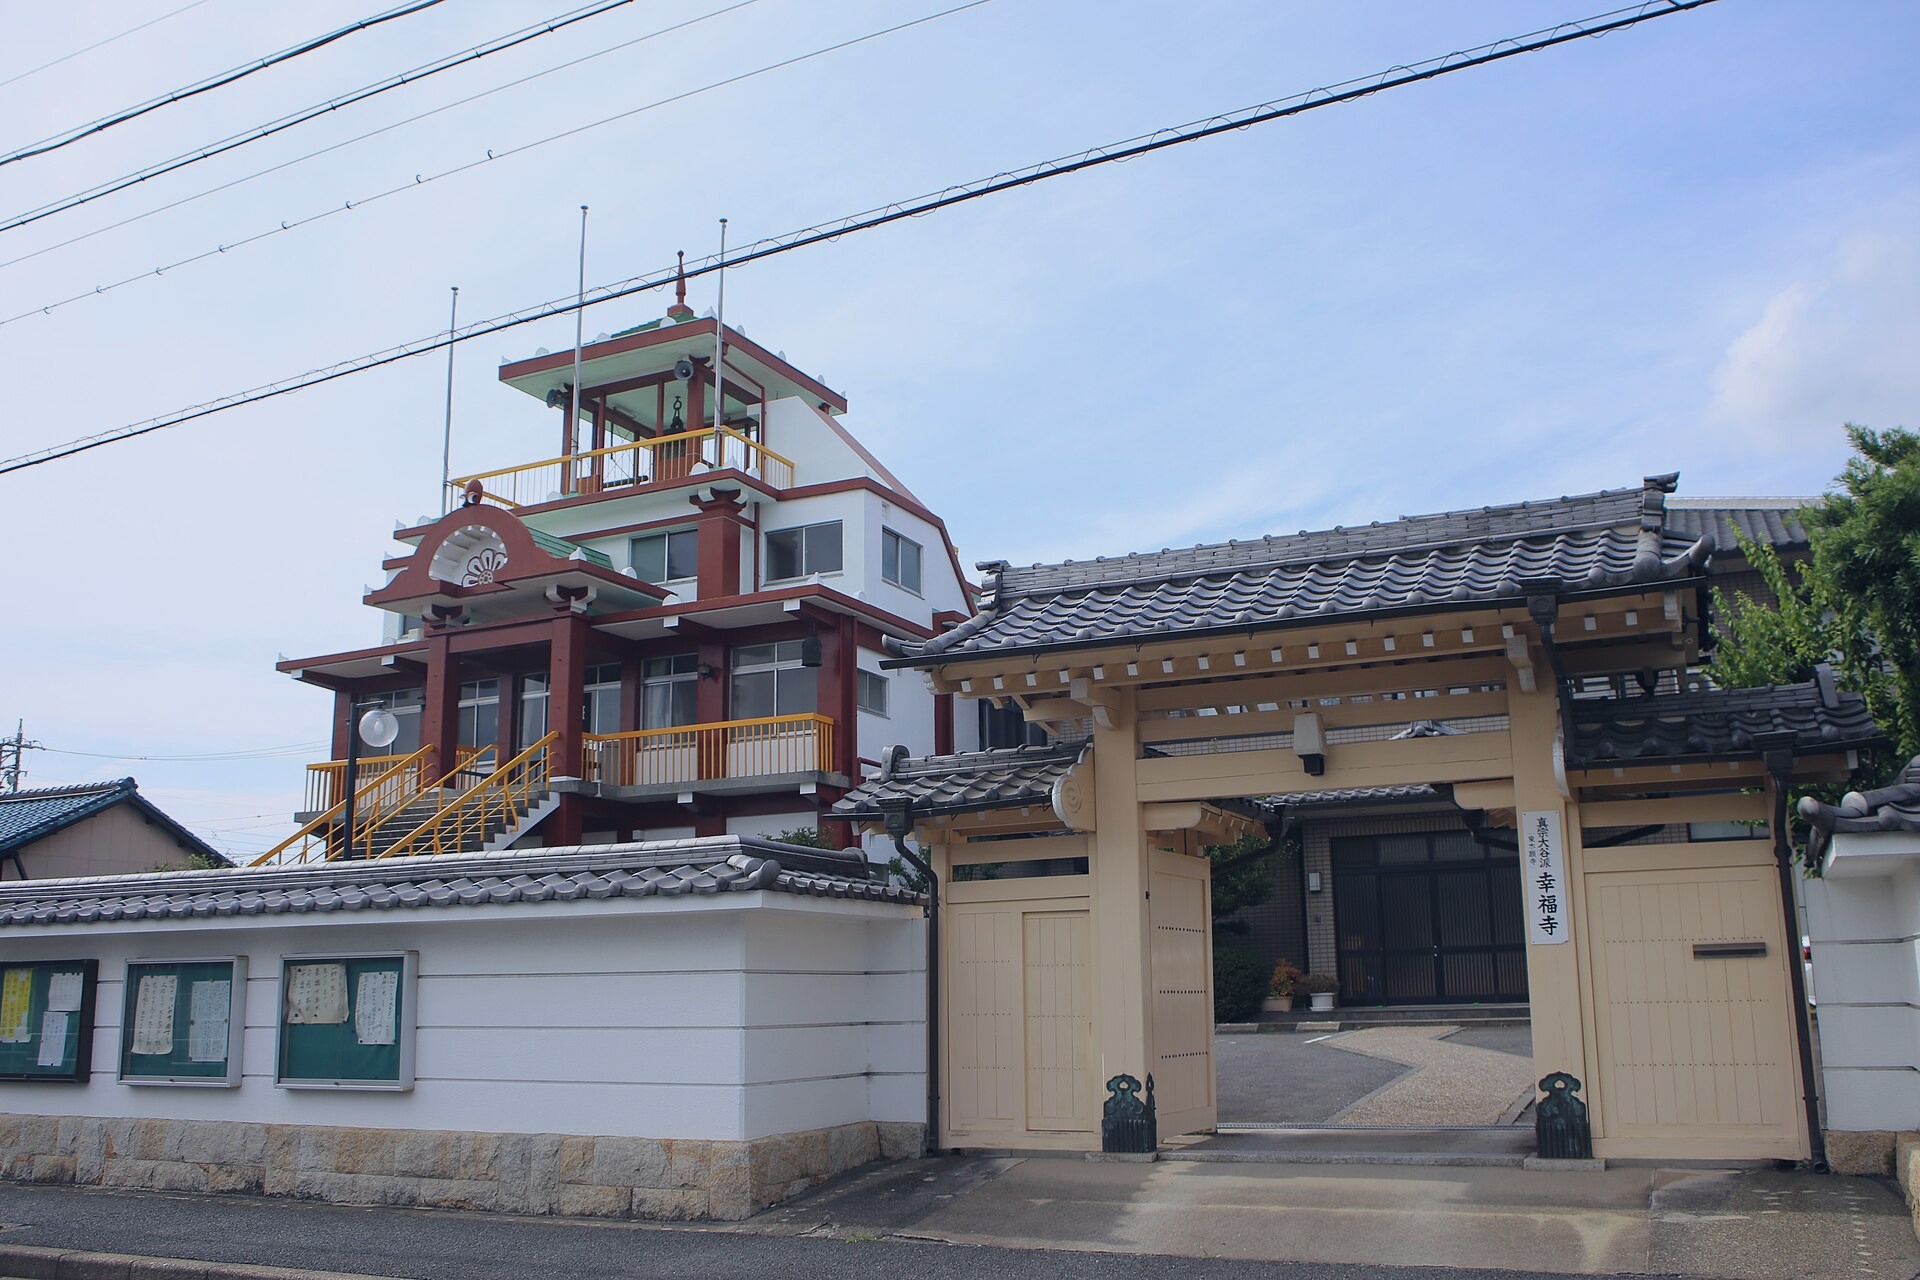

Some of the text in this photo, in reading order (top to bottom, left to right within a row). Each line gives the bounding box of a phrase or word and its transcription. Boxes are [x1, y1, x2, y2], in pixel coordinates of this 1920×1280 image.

[1536, 816, 1559, 936] 真宗大谷派 幸福寺
